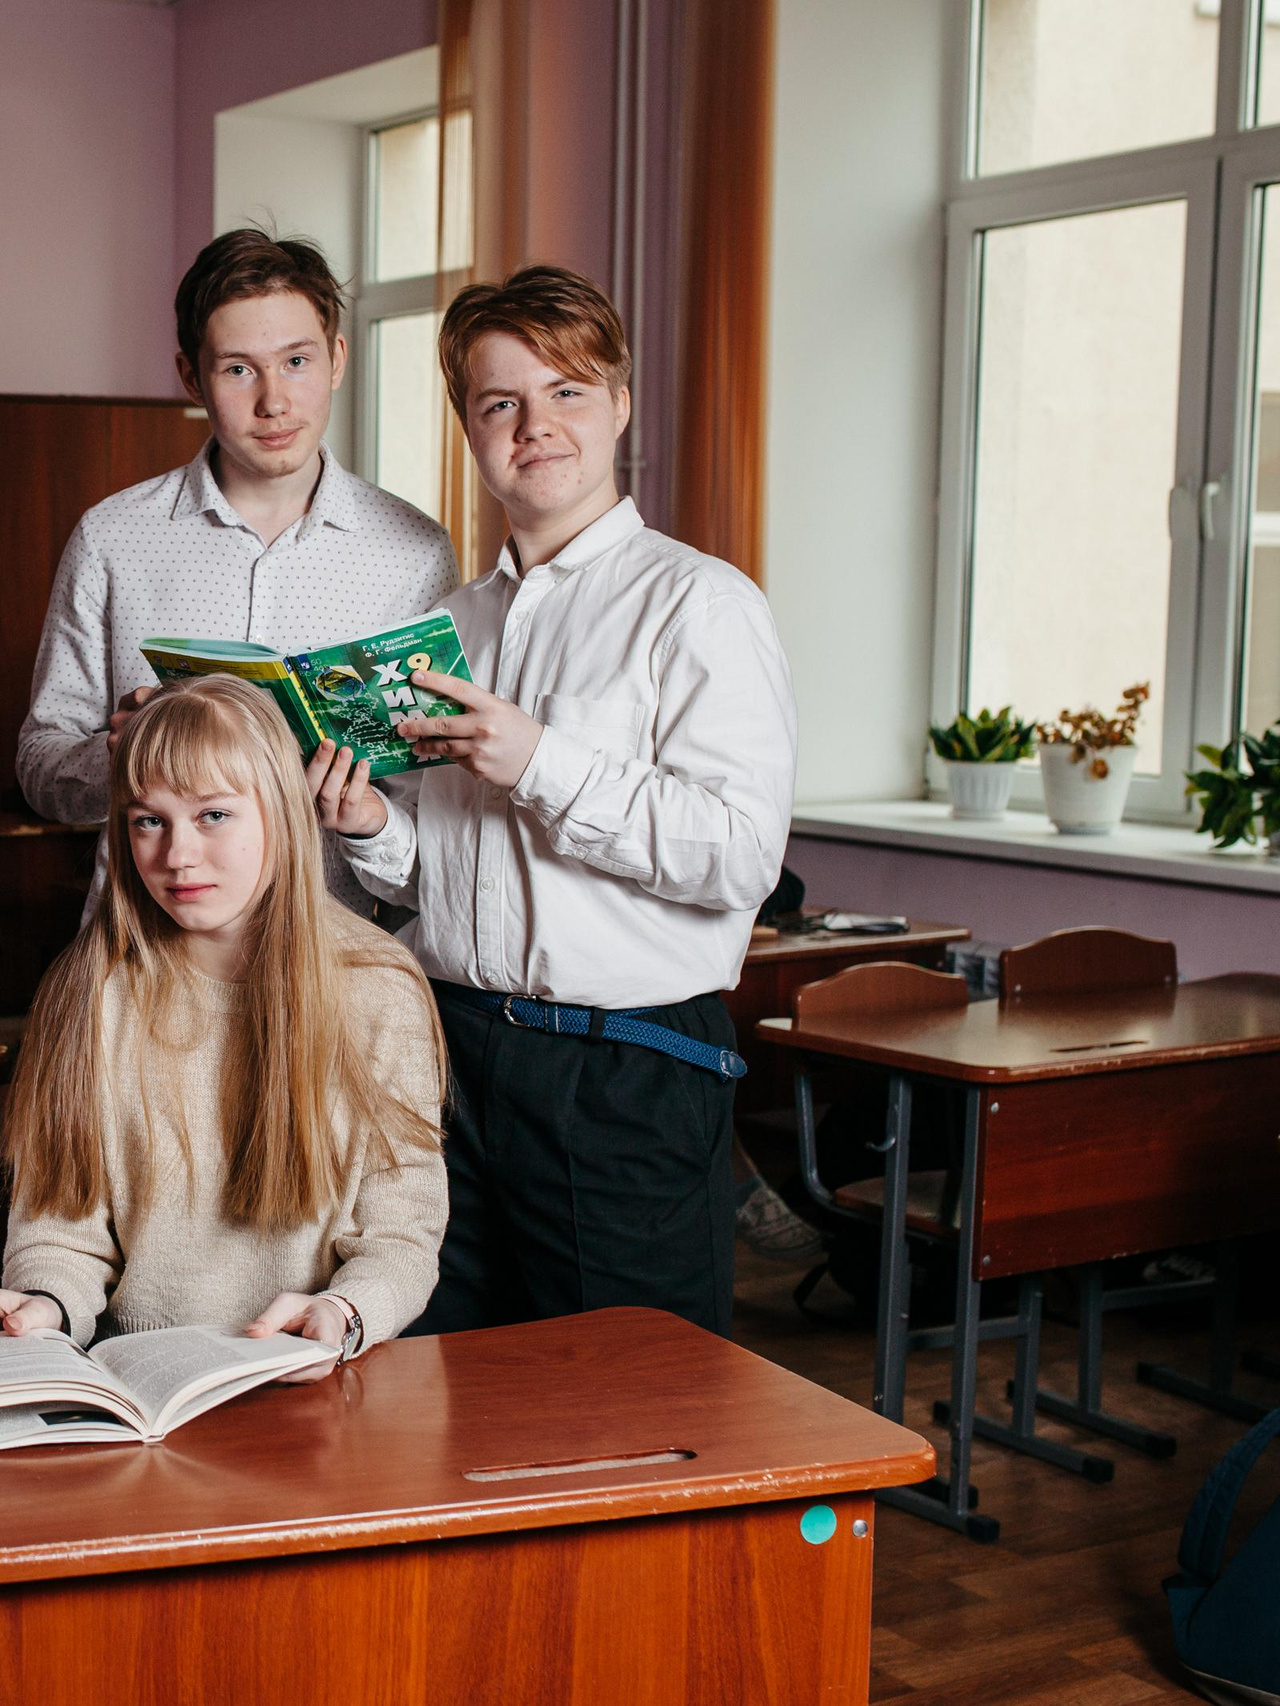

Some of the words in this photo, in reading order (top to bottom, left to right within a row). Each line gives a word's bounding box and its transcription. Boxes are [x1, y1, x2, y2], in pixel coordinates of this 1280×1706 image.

[380, 633, 414, 646] Рудзитис
[384, 638, 423, 652] Фельдман
[407, 652, 431, 671] 9
[371, 659, 441, 763] ХИМ
